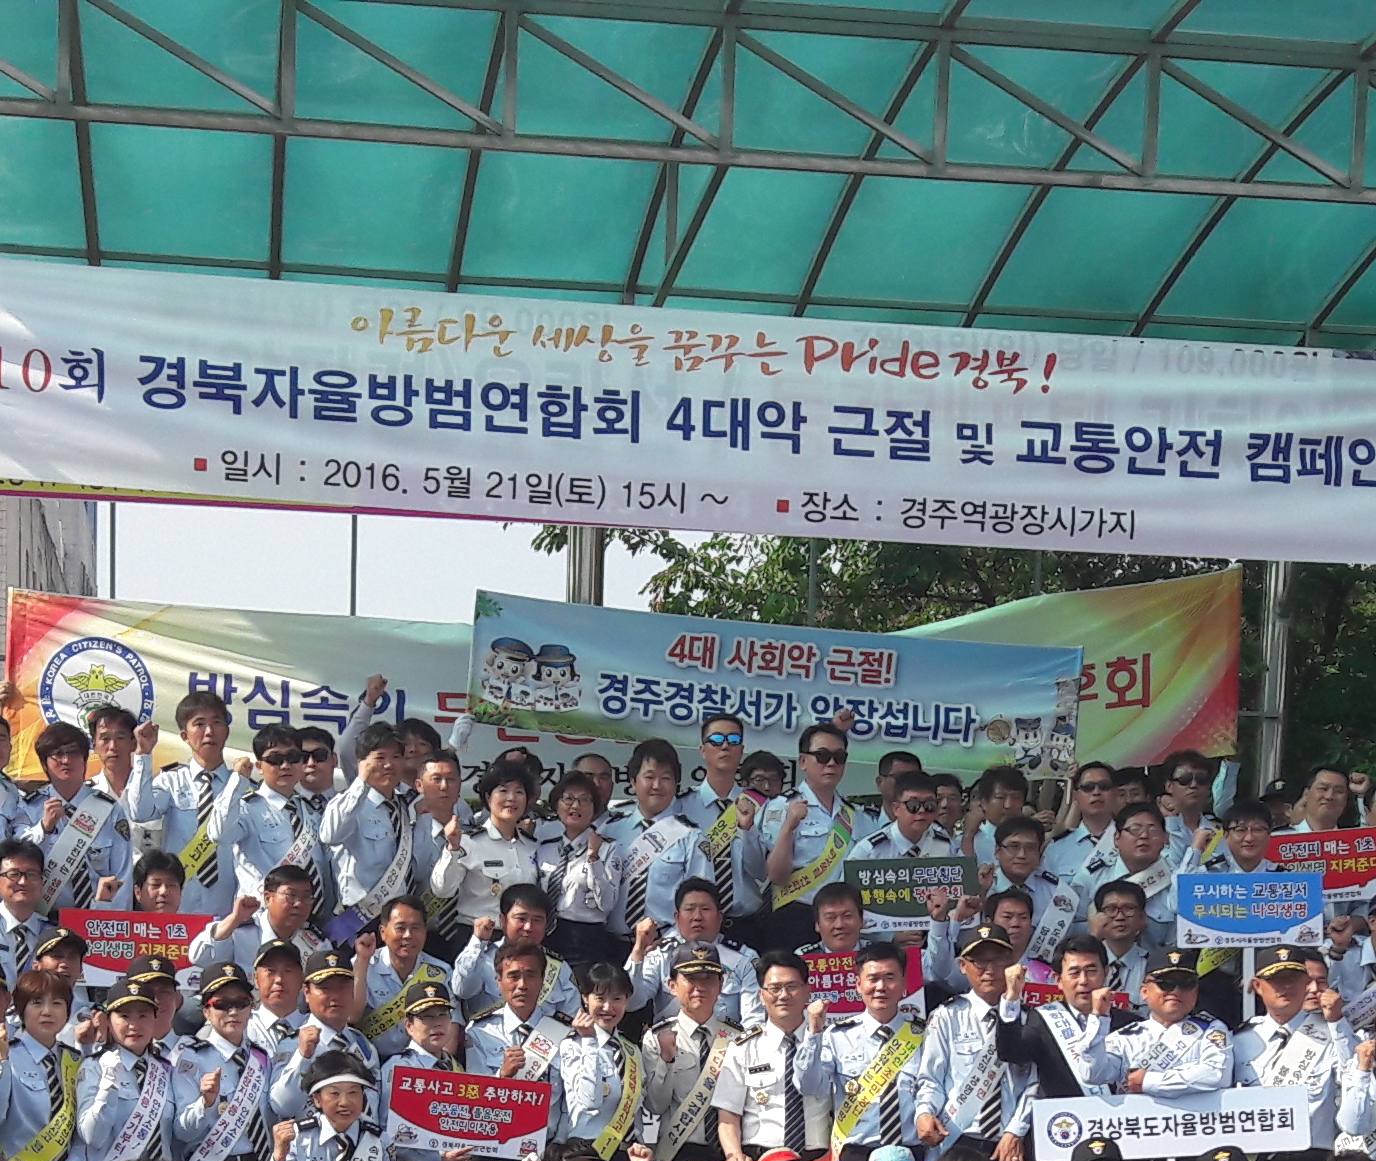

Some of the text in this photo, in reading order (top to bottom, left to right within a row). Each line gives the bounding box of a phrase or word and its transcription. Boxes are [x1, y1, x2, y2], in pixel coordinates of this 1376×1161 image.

[351, 307, 517, 357] 아름다운
[533, 323, 655, 366] 세상을
[663, 330, 788, 376] 꿈꾸는
[796, 335, 940, 379] Pride
[949, 344, 1052, 394] 경북!
[138, 355, 640, 443] 경북자율방범연합회
[666, 397, 807, 454] 4대악
[828, 405, 930, 462] 근절
[956, 421, 995, 465] 및
[1016, 420, 1222, 480] 교통안전
[220, 450, 281, 485] 일시
[324, 459, 408, 495] 2016.
[423, 465, 472, 499] 5월
[485, 472, 606, 509] 21일(토)
[622, 481, 686, 514] 15시
[801, 491, 859, 523] 장소
[900, 498, 1135, 539] 경주역광장시가지
[46, 652, 68, 685] KOREA
[125, 653, 150, 691] PATROL
[667, 634, 893, 685] 4대 사회악 근절!
[598, 672, 797, 731] 경주경찰서가
[1278, 836, 1376, 859] 안전띠 매는 1초
[858, 865, 964, 885] 방심속의 무단횡단
[1192, 881, 1308, 900] 무시하는 교통질서
[86, 919, 188, 940] 안전띠 매는 1초
[1193, 902, 1308, 919] 무시되는 나의생명
[223, 1065, 259, 1117] 방향지시등
[399, 1076, 454, 1096] 교통사고
[483, 1087, 544, 1106] 추방하자!
[1087, 1107, 1295, 1141] 경상북도자율방범연합회
